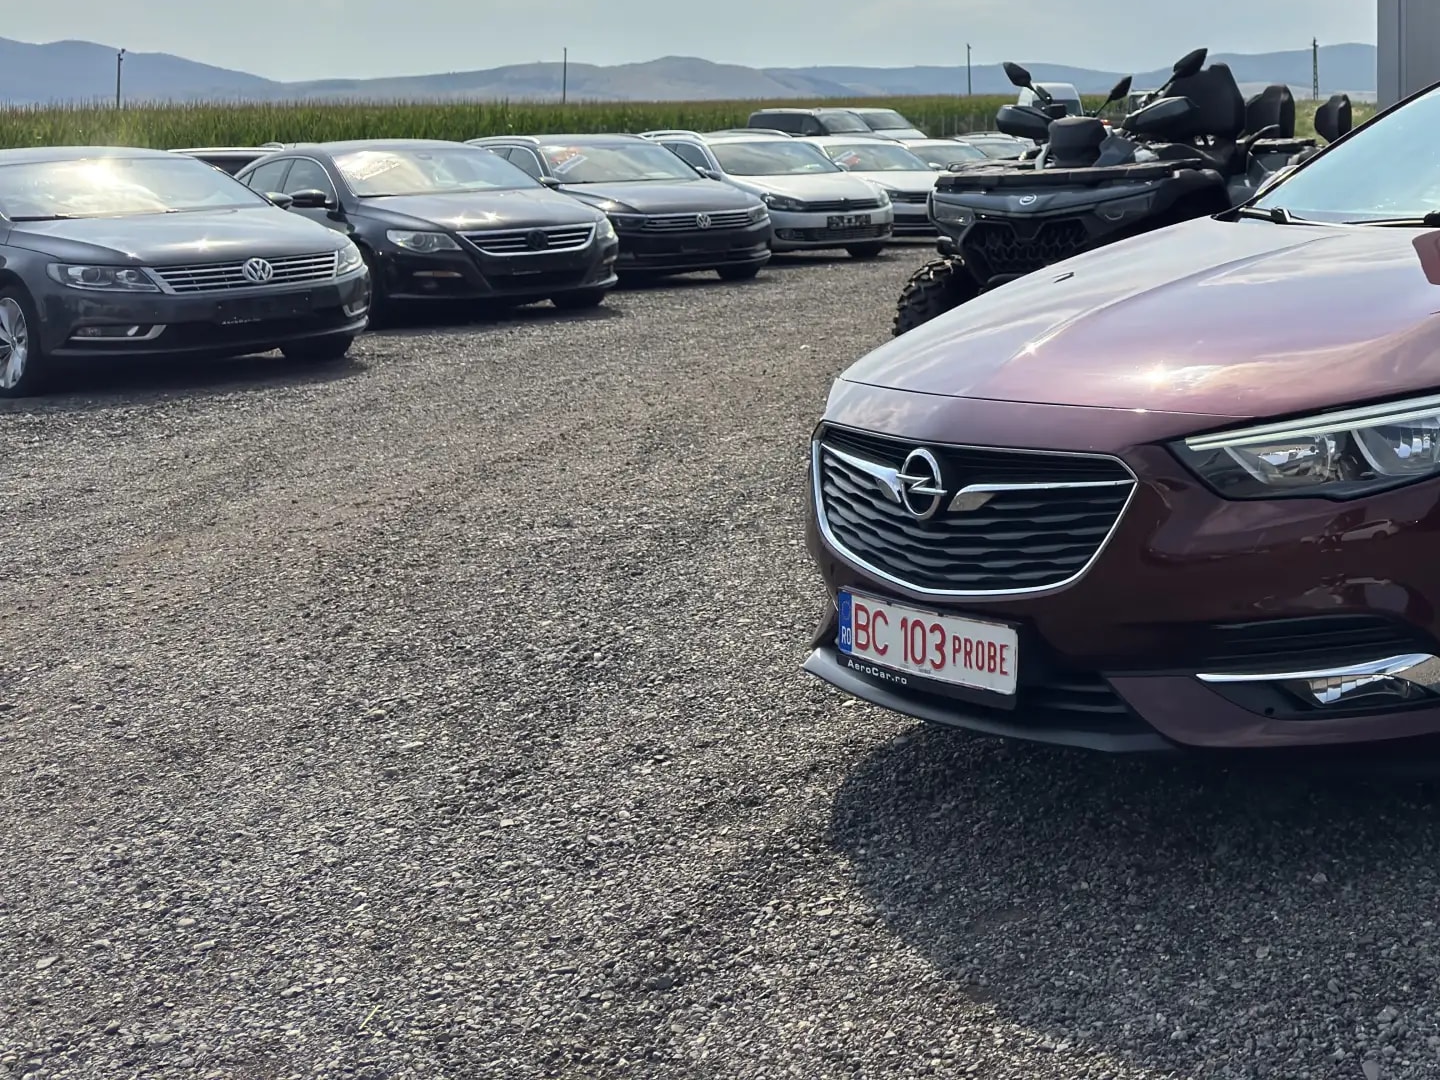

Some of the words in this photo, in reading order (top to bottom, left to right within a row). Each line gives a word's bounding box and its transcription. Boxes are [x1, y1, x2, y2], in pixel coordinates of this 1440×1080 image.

[841, 625, 852, 645] RO
[854, 602, 889, 657] BC
[900, 615, 947, 672] 103
[952, 634, 1009, 676] PROBE
[847, 659, 908, 685] AeroCar.ro
